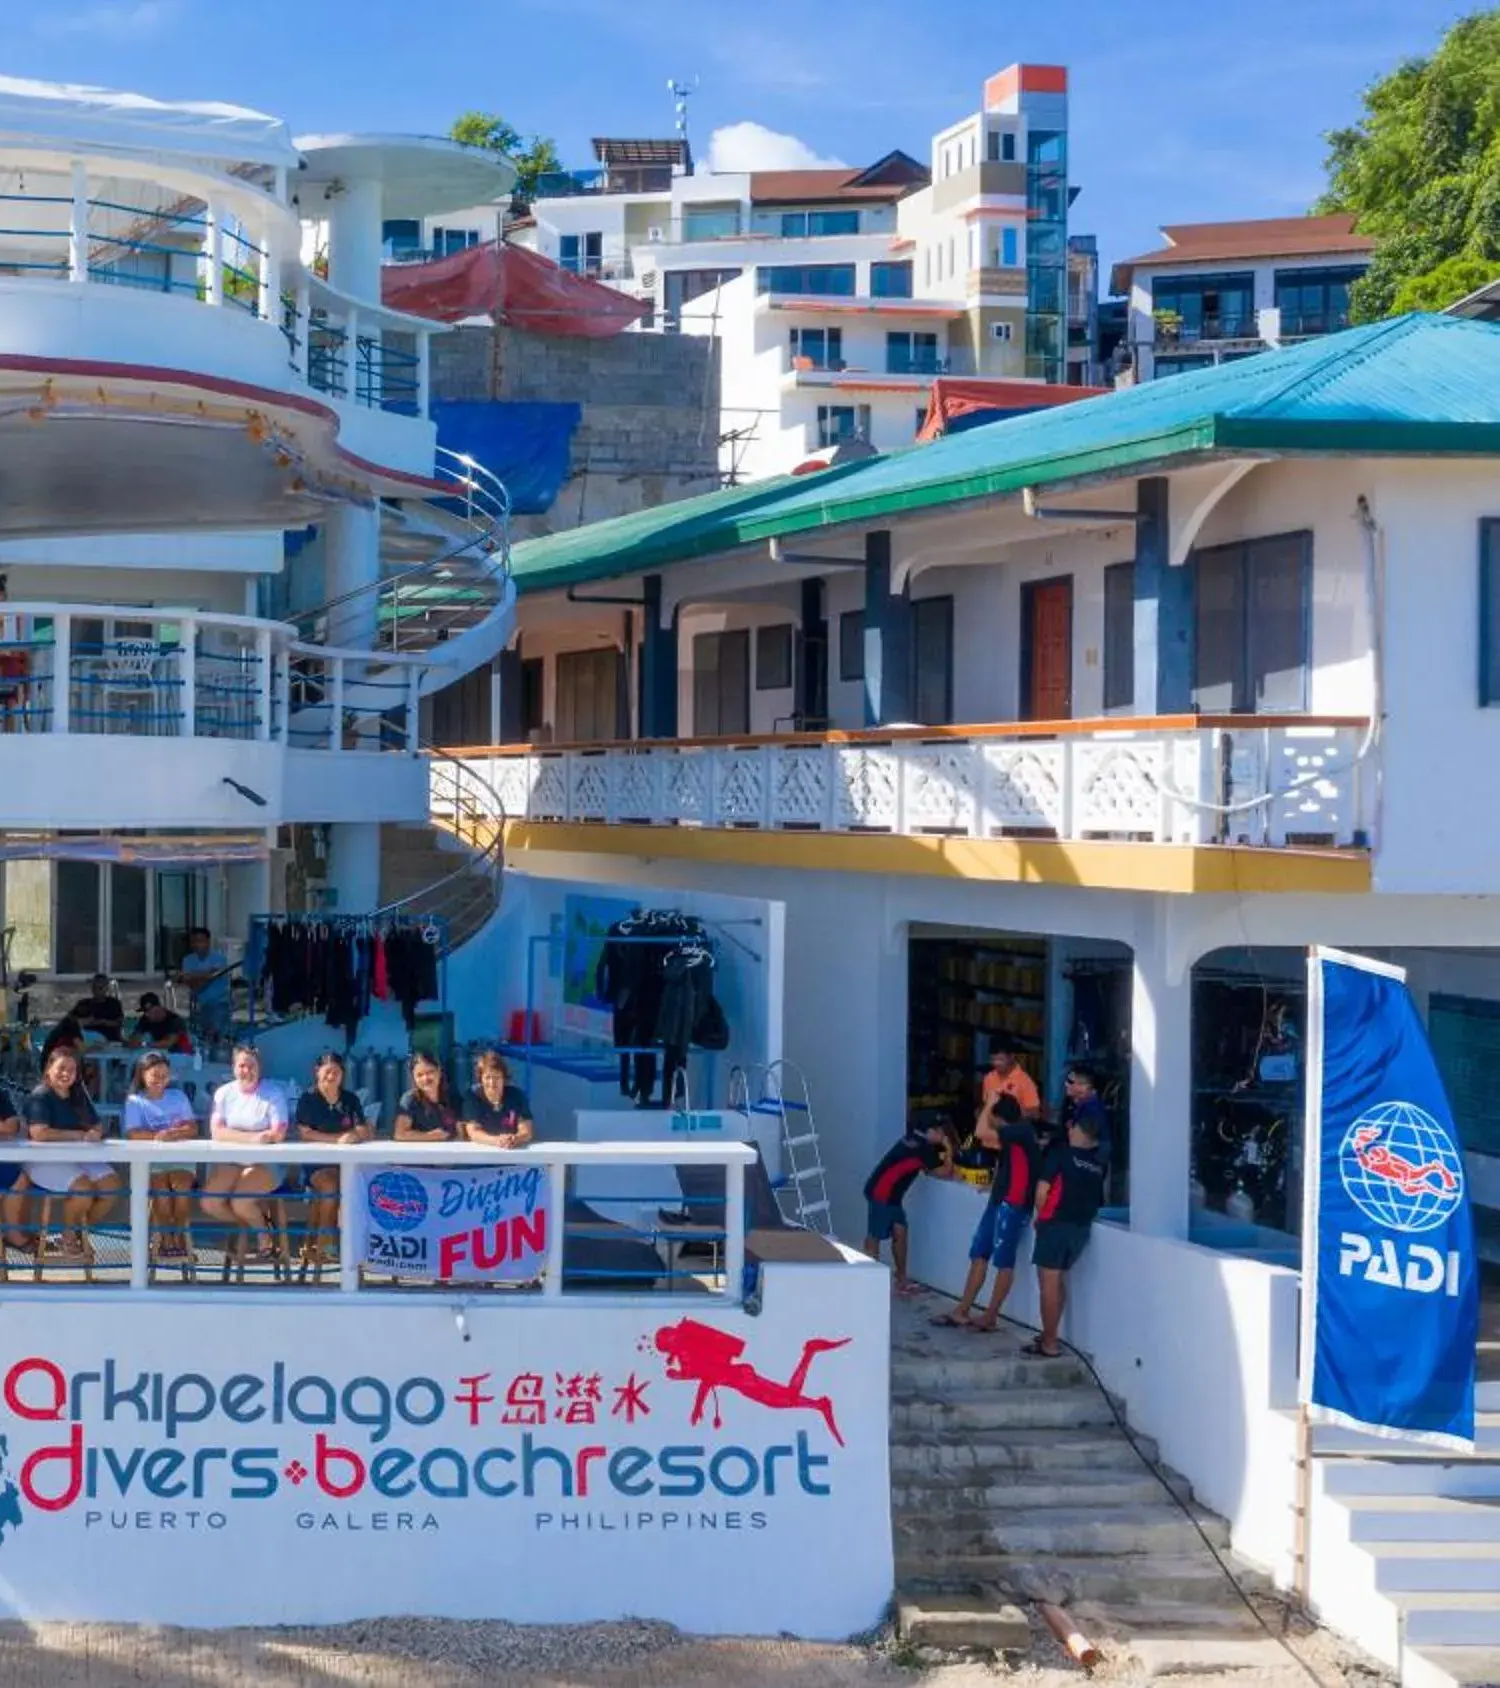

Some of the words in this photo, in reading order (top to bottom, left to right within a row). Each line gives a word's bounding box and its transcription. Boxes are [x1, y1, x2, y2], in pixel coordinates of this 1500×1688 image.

[438, 1167, 542, 1218] Diving
[369, 1233, 427, 1259] PADI
[440, 1208, 545, 1279] FUN
[1340, 1232, 1459, 1297] PADI
[3, 1357, 445, 1443] arkipelago
[455, 1372, 651, 1426] 千岛潜水
[20, 1424, 279, 1511] divers
[85, 1511, 227, 1530] PUERTO
[296, 1511, 440, 1531] GALERA
[536, 1512, 768, 1530] PHILIPPINES
